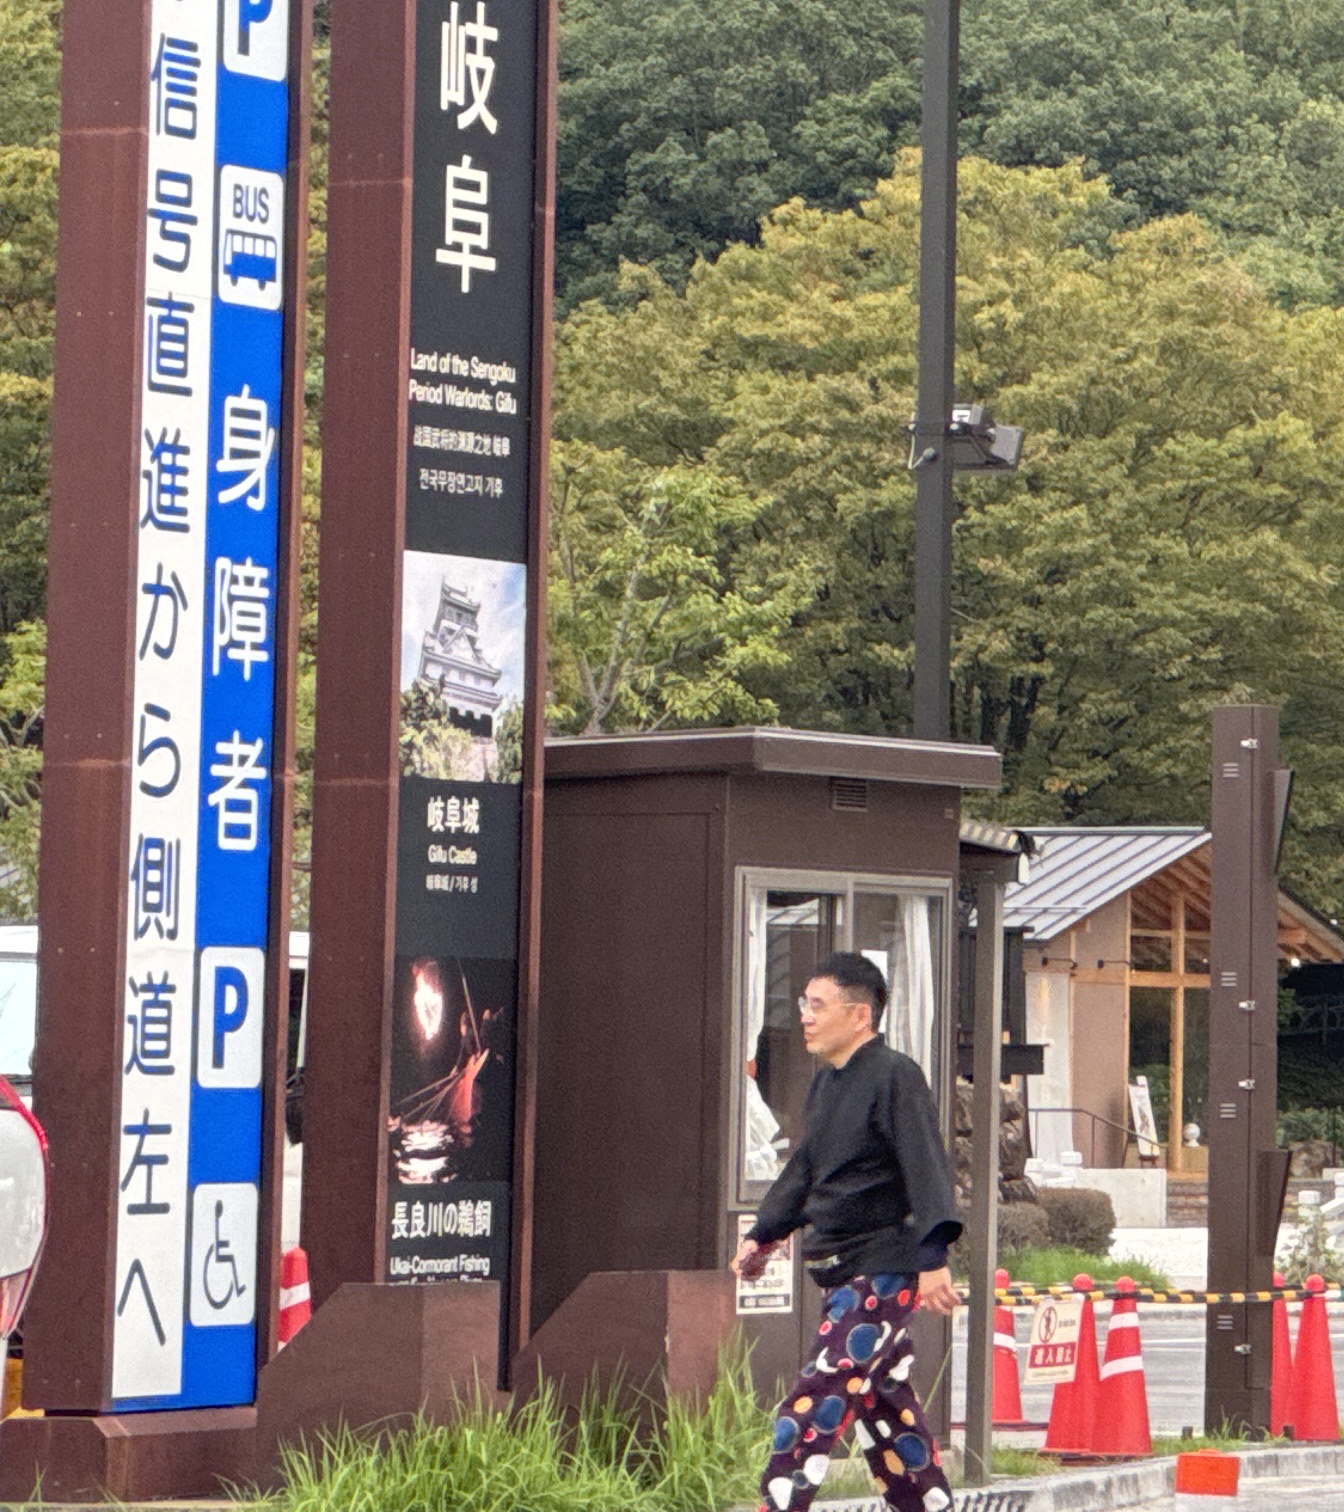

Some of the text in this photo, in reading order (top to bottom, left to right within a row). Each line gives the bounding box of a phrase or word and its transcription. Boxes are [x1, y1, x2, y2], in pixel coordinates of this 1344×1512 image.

[436, 1, 498, 293] 岐阜
[232, 184, 270, 225] BUS
[411, 348, 516, 386] Land of the Sengoku
[409, 379, 517, 414] Period Warlords: Gifu
[208, 385, 275, 851] 身障者
[427, 795, 479, 834] 岐阜城
[428, 844, 477, 865] Gifu Castle
[212, 965, 248, 1070] P
[459, 1253, 490, 1277] Fishing
